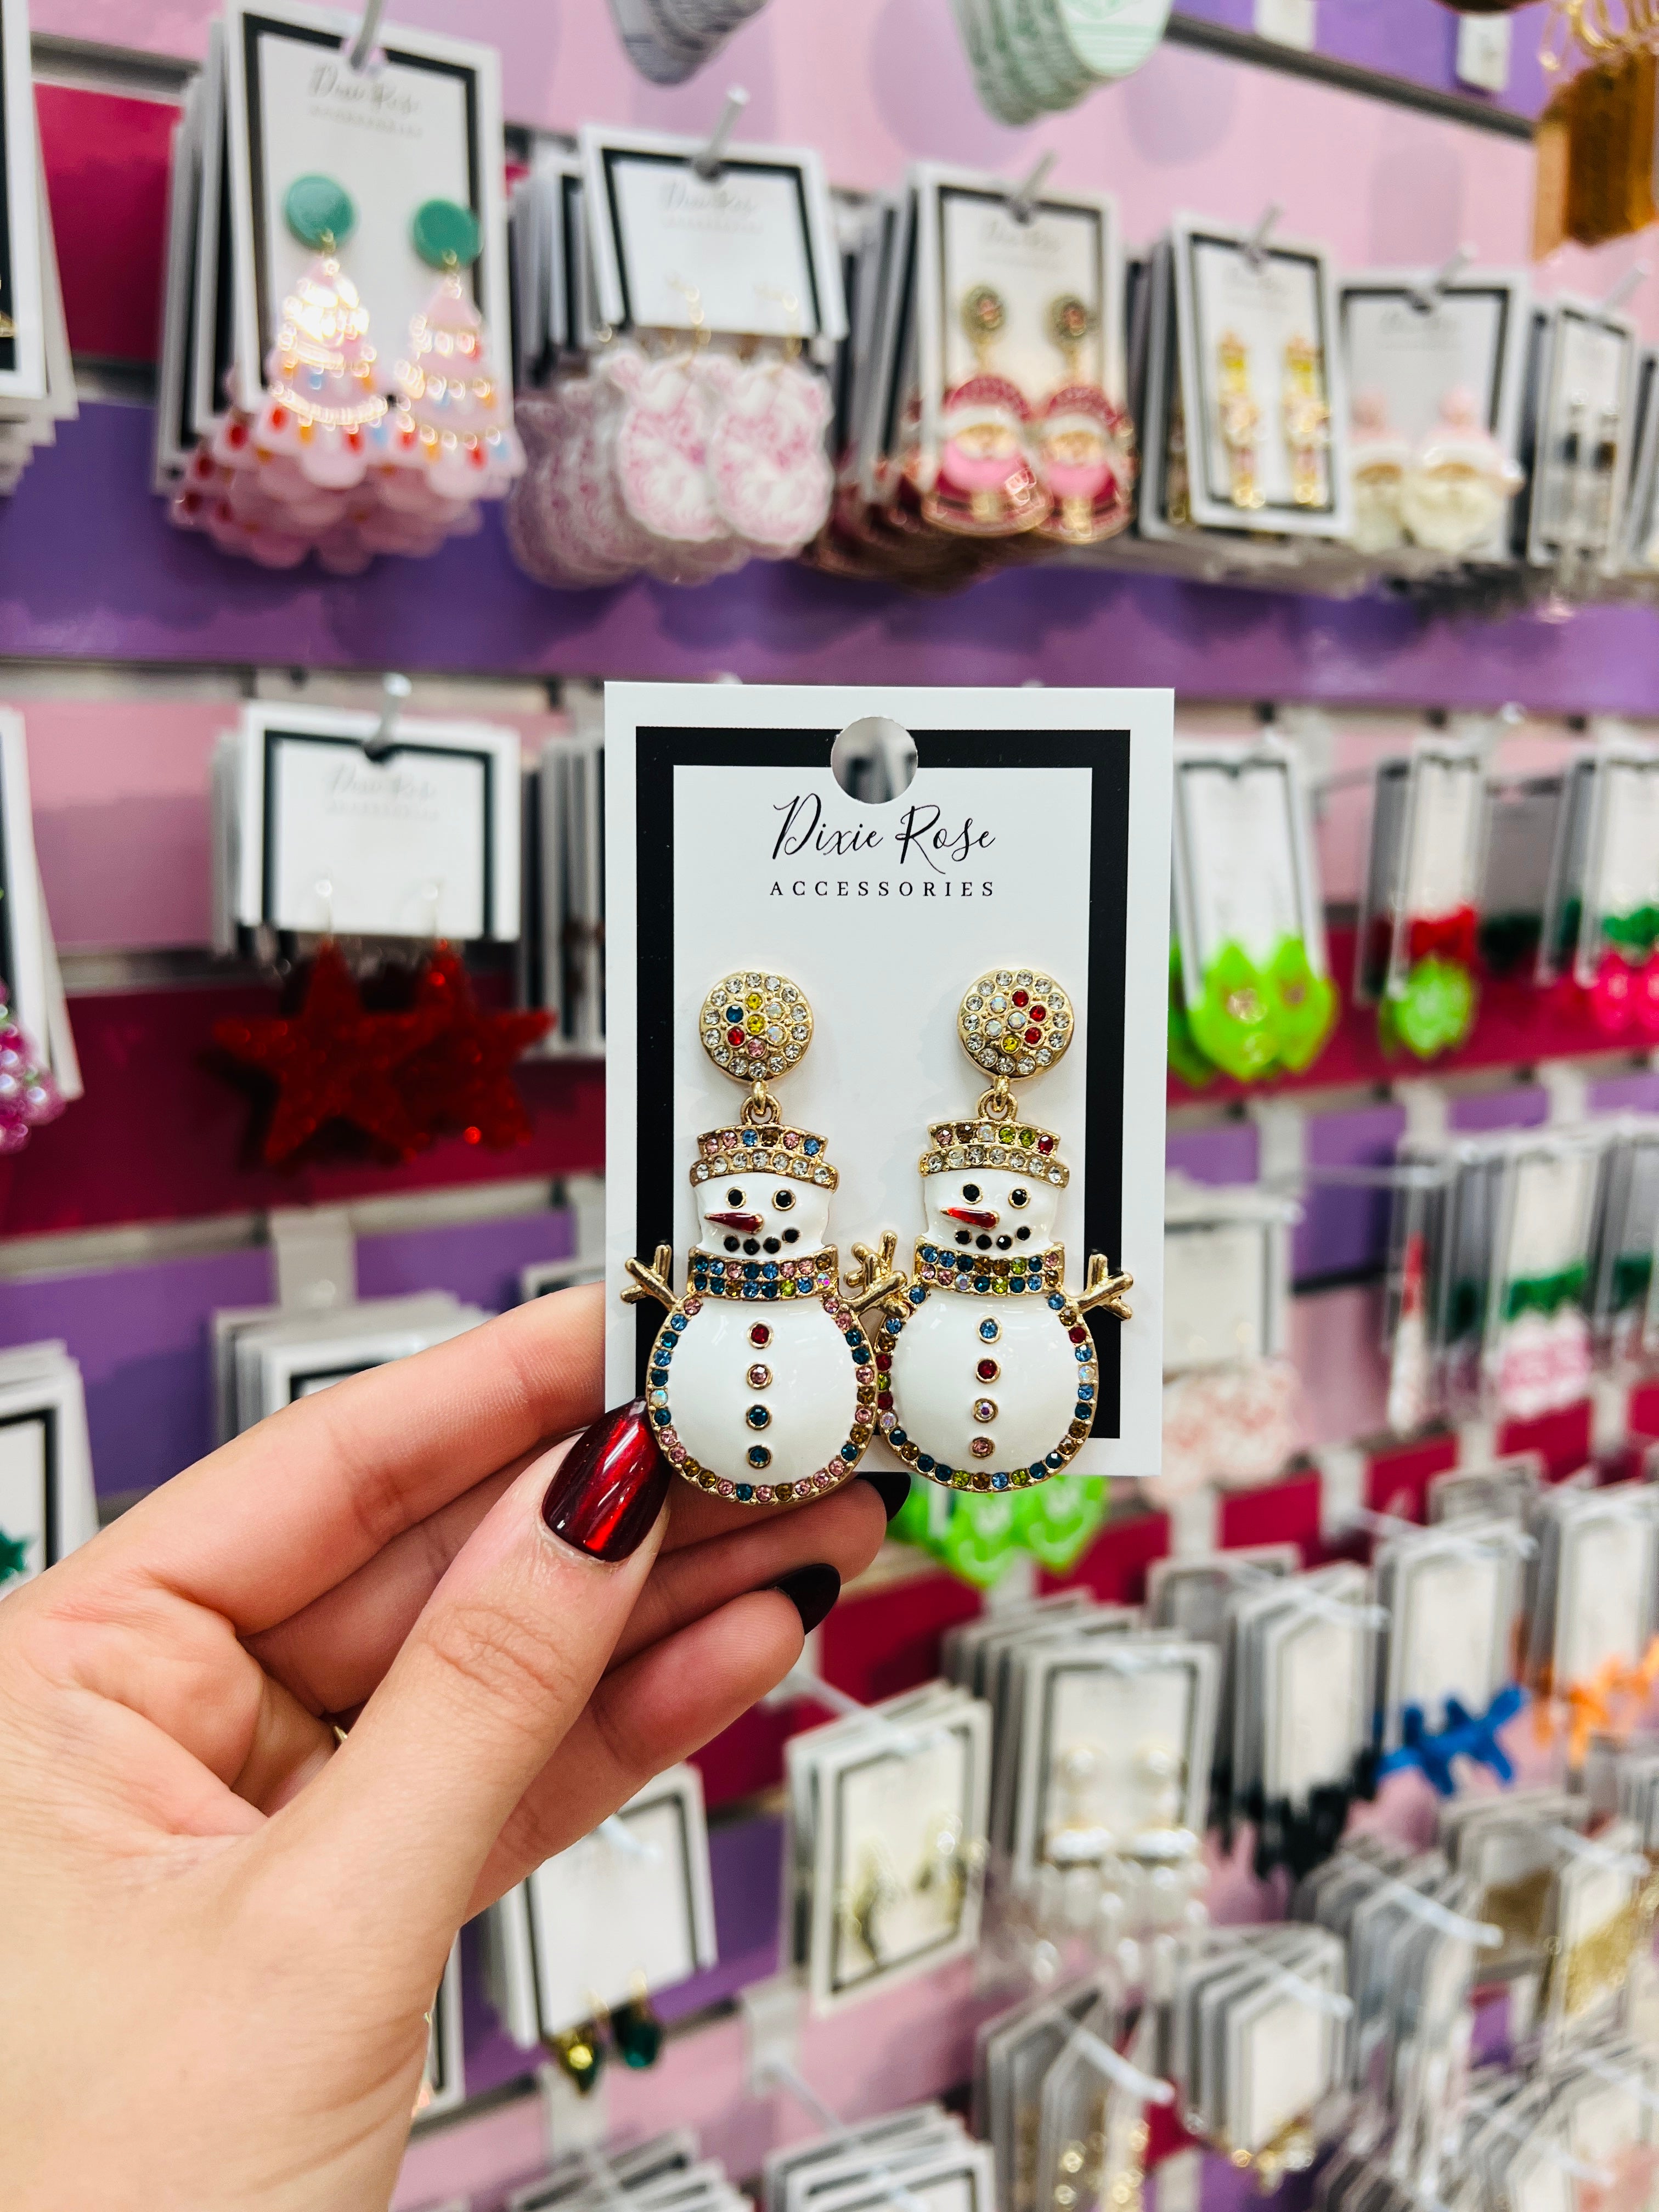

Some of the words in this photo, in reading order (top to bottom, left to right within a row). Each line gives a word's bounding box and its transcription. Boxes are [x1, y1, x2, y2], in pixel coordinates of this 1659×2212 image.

[772, 793, 884, 860] Dixie
[895, 804, 996, 874] Rose
[770, 881, 993, 897] ACCESSORIES
